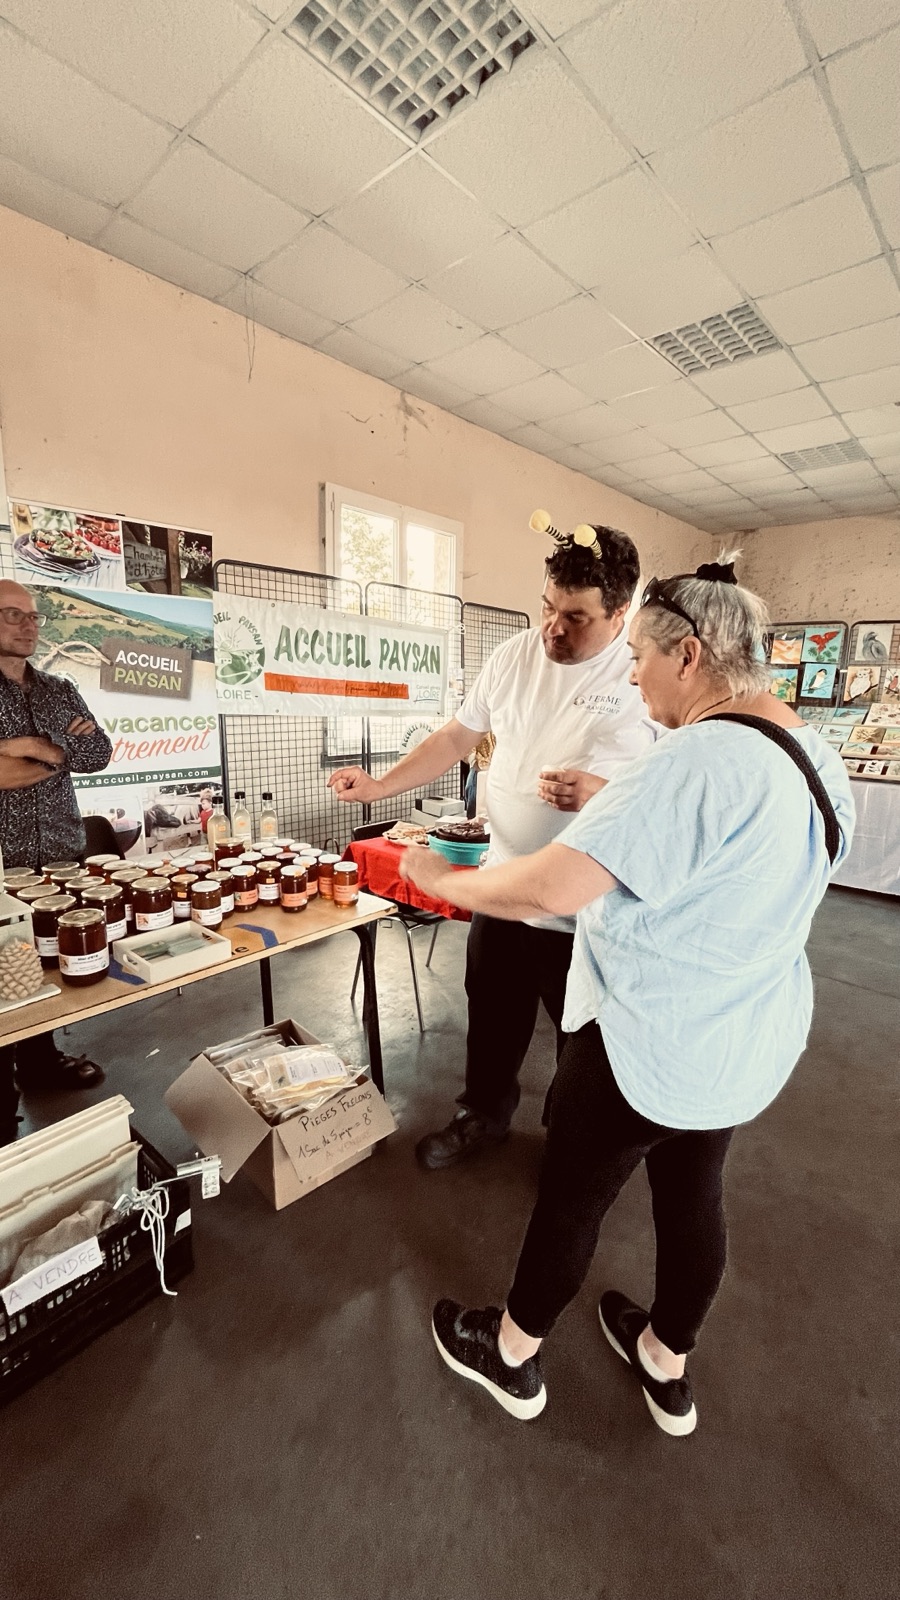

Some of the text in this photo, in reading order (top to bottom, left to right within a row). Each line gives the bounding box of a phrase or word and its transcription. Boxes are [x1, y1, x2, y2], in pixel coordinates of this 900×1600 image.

[238, 616, 263, 645] PAYSAN
[274, 625, 440, 674] ACCUEIL PAYSAN
[115, 650, 182, 673] ACCUEIL
[114, 667, 182, 691] PAYSAN
[216, 689, 251, 700] LOIRE
[419, 690, 440, 699] LOIRE
[588, 695, 622, 705] FERME
[104, 715, 217, 734] vacances
[9, 1247, 98, 1305] A VENDRE
